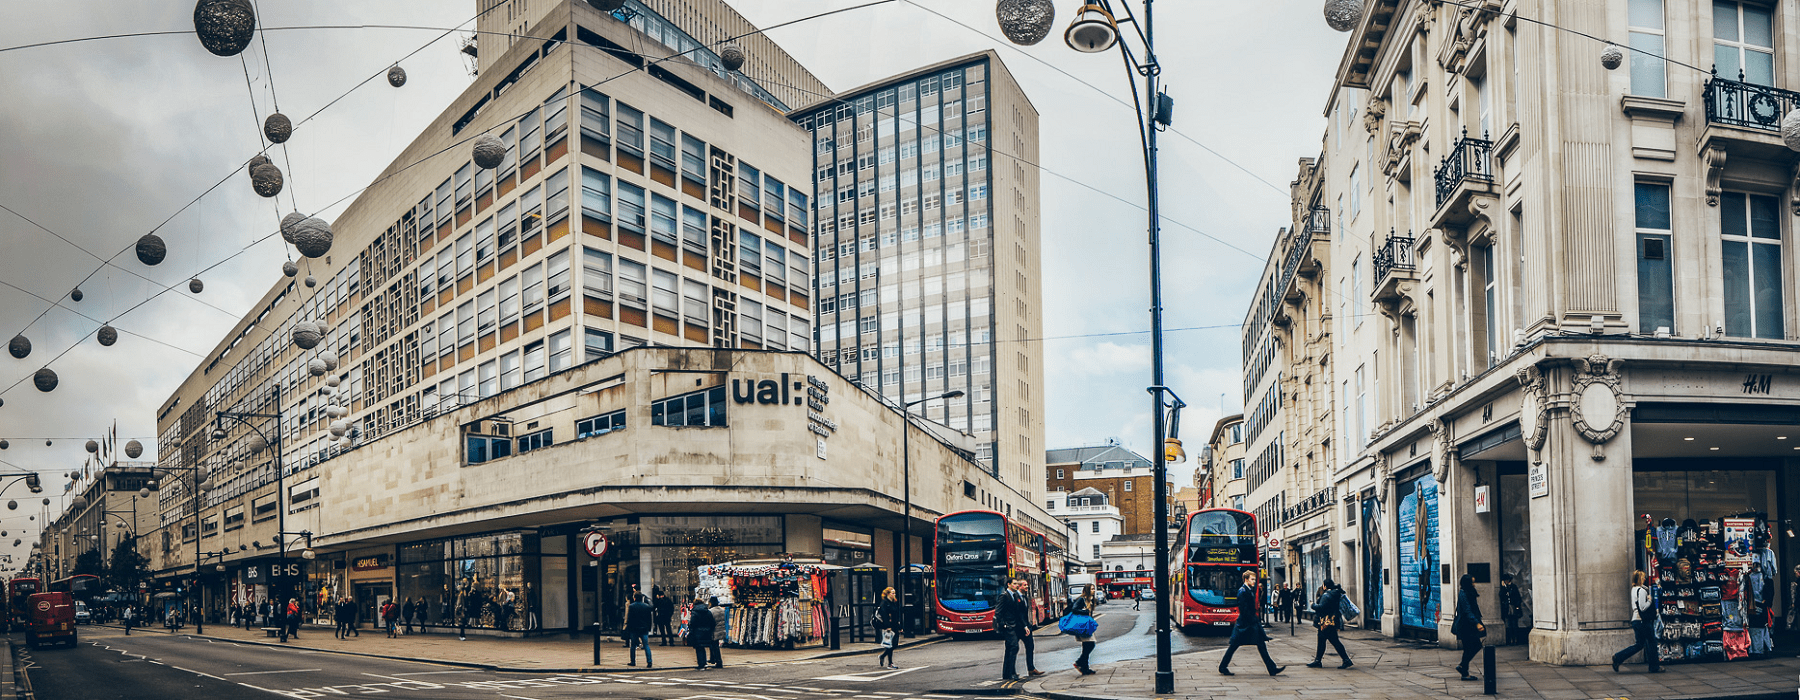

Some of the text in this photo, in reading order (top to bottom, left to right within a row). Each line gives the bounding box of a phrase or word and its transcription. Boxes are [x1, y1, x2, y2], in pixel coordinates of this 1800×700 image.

[1742, 373, 1773, 395] H&M
[986, 550, 993, 561] 7
[247, 565, 258, 578] BHS
